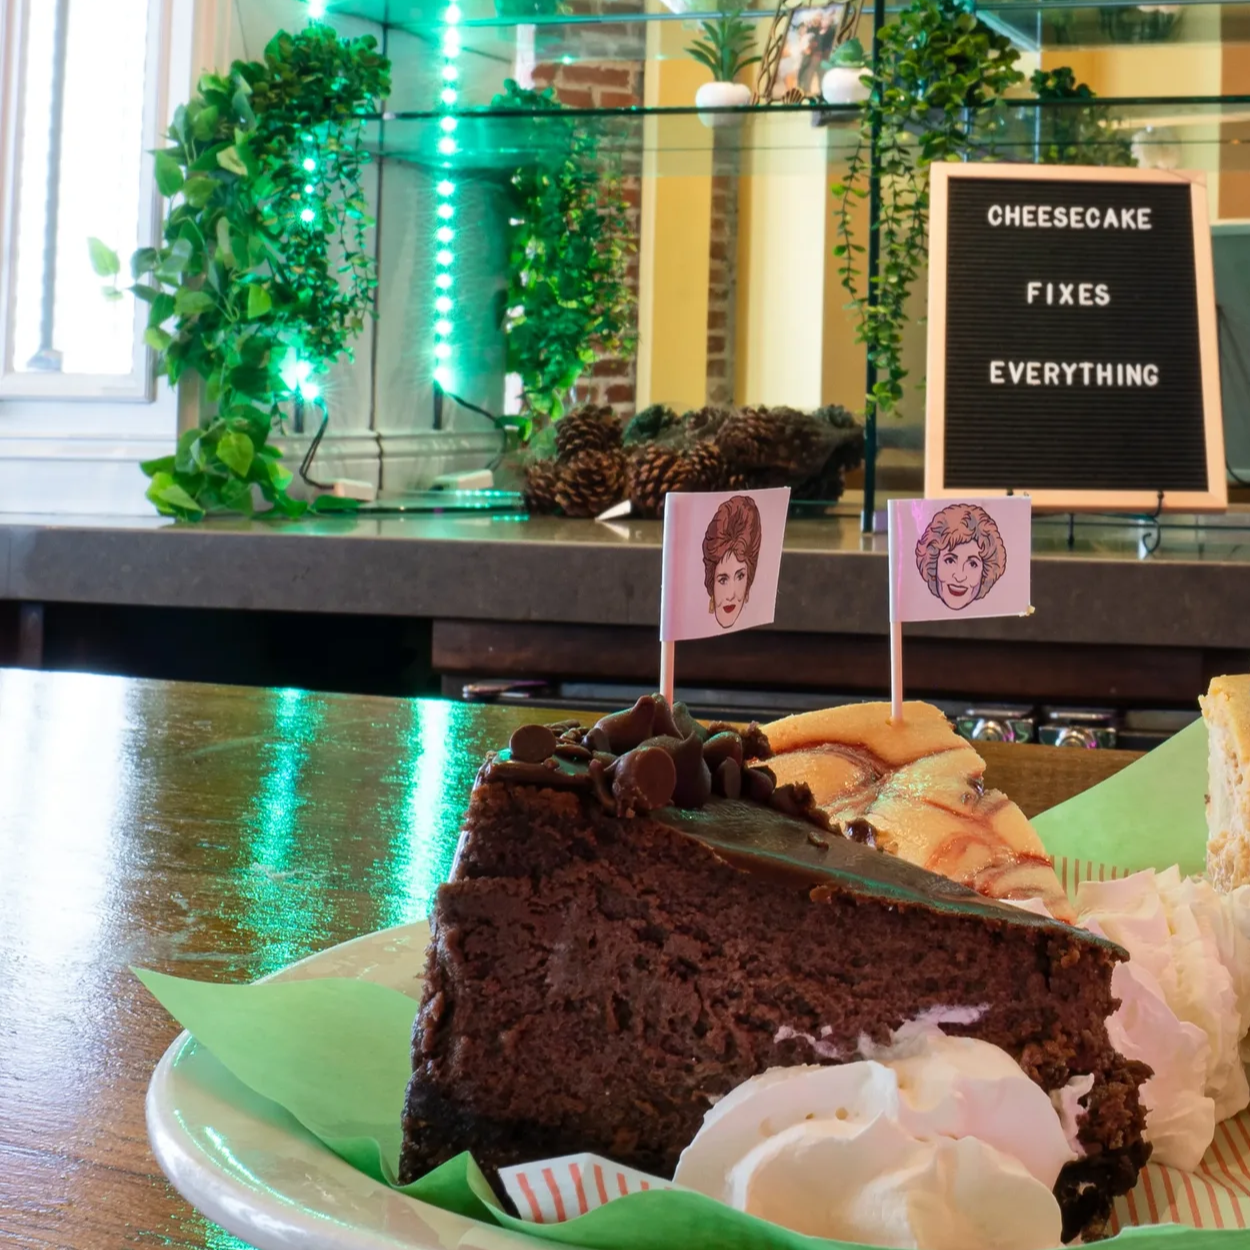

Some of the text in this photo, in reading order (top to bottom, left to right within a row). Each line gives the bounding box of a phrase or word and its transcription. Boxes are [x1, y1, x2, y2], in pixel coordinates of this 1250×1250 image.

[987, 205, 1153, 230] CHEESECAKE
[1026, 281, 1111, 306] FIXES
[989, 360, 1160, 387] EVERYTHING
